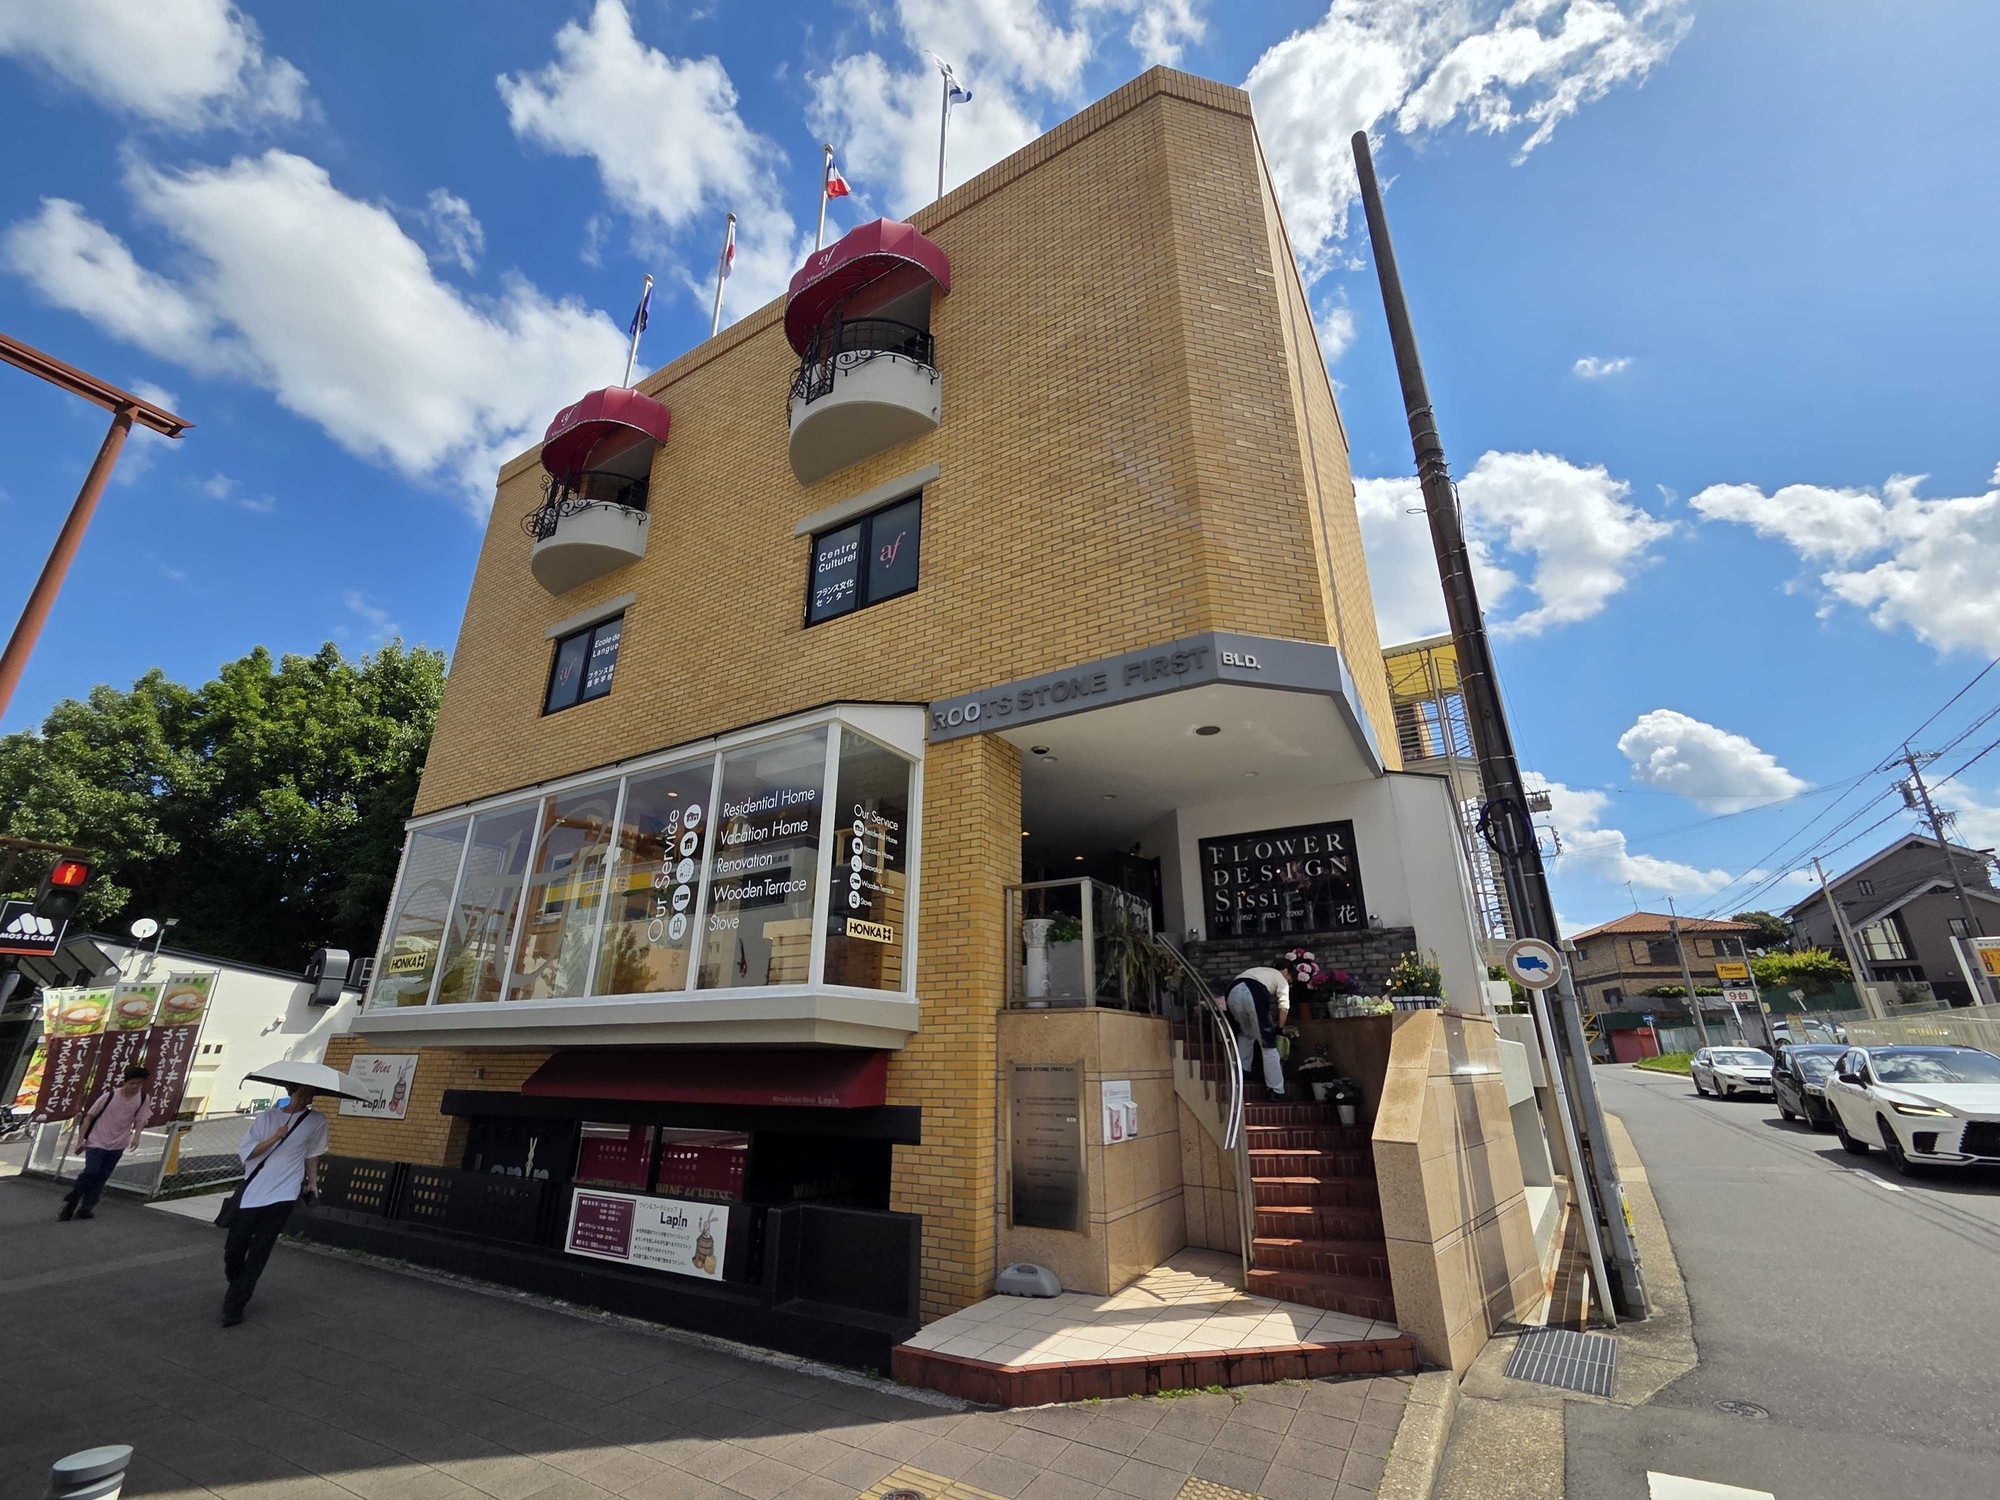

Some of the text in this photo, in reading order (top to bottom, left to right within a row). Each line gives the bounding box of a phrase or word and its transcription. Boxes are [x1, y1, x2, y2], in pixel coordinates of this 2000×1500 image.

[819, 541, 858, 562] Centre
[818, 551, 857, 573] Culturel
[816, 578, 854, 599] フランス文化
[816, 589, 854, 607] センター
[592, 643, 620, 658] Langue
[933, 645, 1261, 731] ROOTS STONE FIRST BLD.
[723, 789, 815, 818] Residential Home
[853, 804, 899, 831] Our Service
[720, 820, 808, 845] Vacation Home
[885, 834, 898, 845] Home
[862, 844, 894, 861] Vacation Home
[1208, 833, 1345, 865] FLOWER
[716, 854, 773, 874] Renovation
[1213, 856, 1348, 886] DESIGN
[647, 809, 680, 942] Our Service
[861, 880, 880, 891] Wooden
[713, 878, 807, 901] Wooden Terrace
[860, 897, 873, 907] Stove
[1215, 888, 1279, 912] Sissi
[708, 913, 740, 932] Stove
[1336, 904, 1358, 924] 花
[0, 932, 22, 940] MOS
[849, 921, 882, 938] HONKA
[390, 957, 417, 970] HONKA
[1729, 991, 1748, 1000] 9台
[373, 1059, 392, 1074] Wine
[818, 1094, 840, 1106] Lapin
[660, 1208, 688, 1230] Lapin
